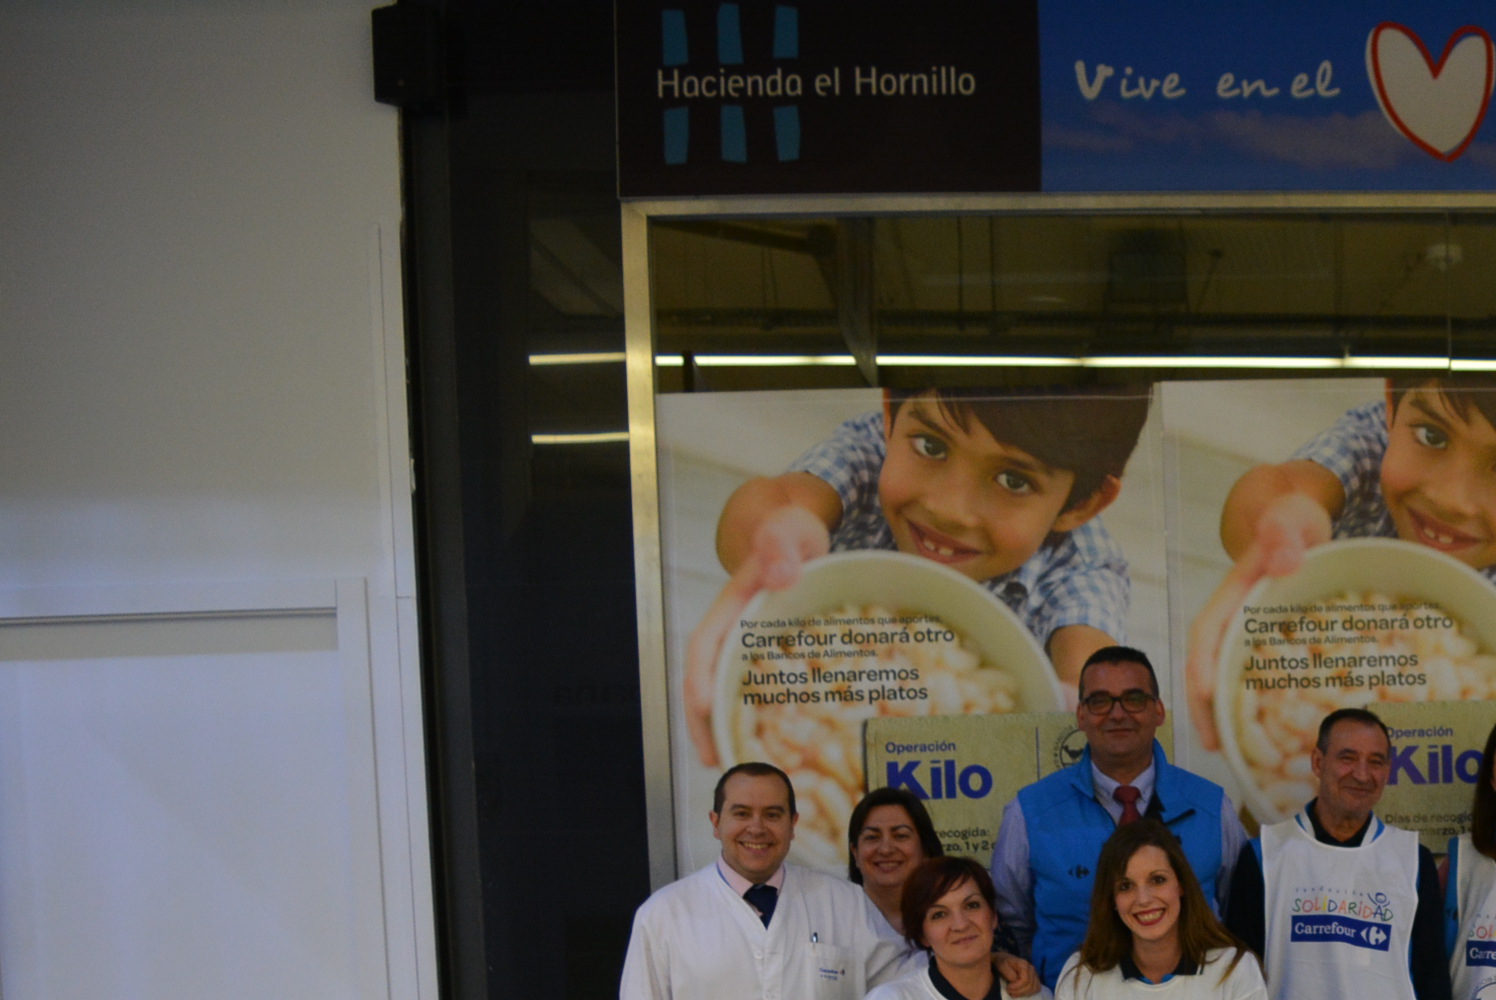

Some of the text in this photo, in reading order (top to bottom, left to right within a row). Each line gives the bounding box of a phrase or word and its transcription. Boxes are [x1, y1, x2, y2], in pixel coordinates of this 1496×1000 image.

[656, 65, 977, 99] Hacienda el Hornillo
[1074, 59, 1341, 101] Vive en el
[760, 618, 786, 629] cada
[809, 617, 821, 627] de
[823, 616, 875, 627] alimentos
[1244, 612, 1454, 634] Carrefour donará otro
[741, 626, 955, 648] Carrefour donará otro
[767, 650, 806, 660] Bancos
[807, 650, 821, 659] de
[1245, 652, 1419, 672] Juntos llenaremos
[742, 667, 919, 686] Juntos llenaremos
[1245, 671, 1427, 690] muchos más platos
[743, 685, 928, 705] muchos más platos
[885, 741, 956, 755] Operación
[886, 759, 993, 801] Kilo
[1294, 921, 1357, 938] Carrefour
